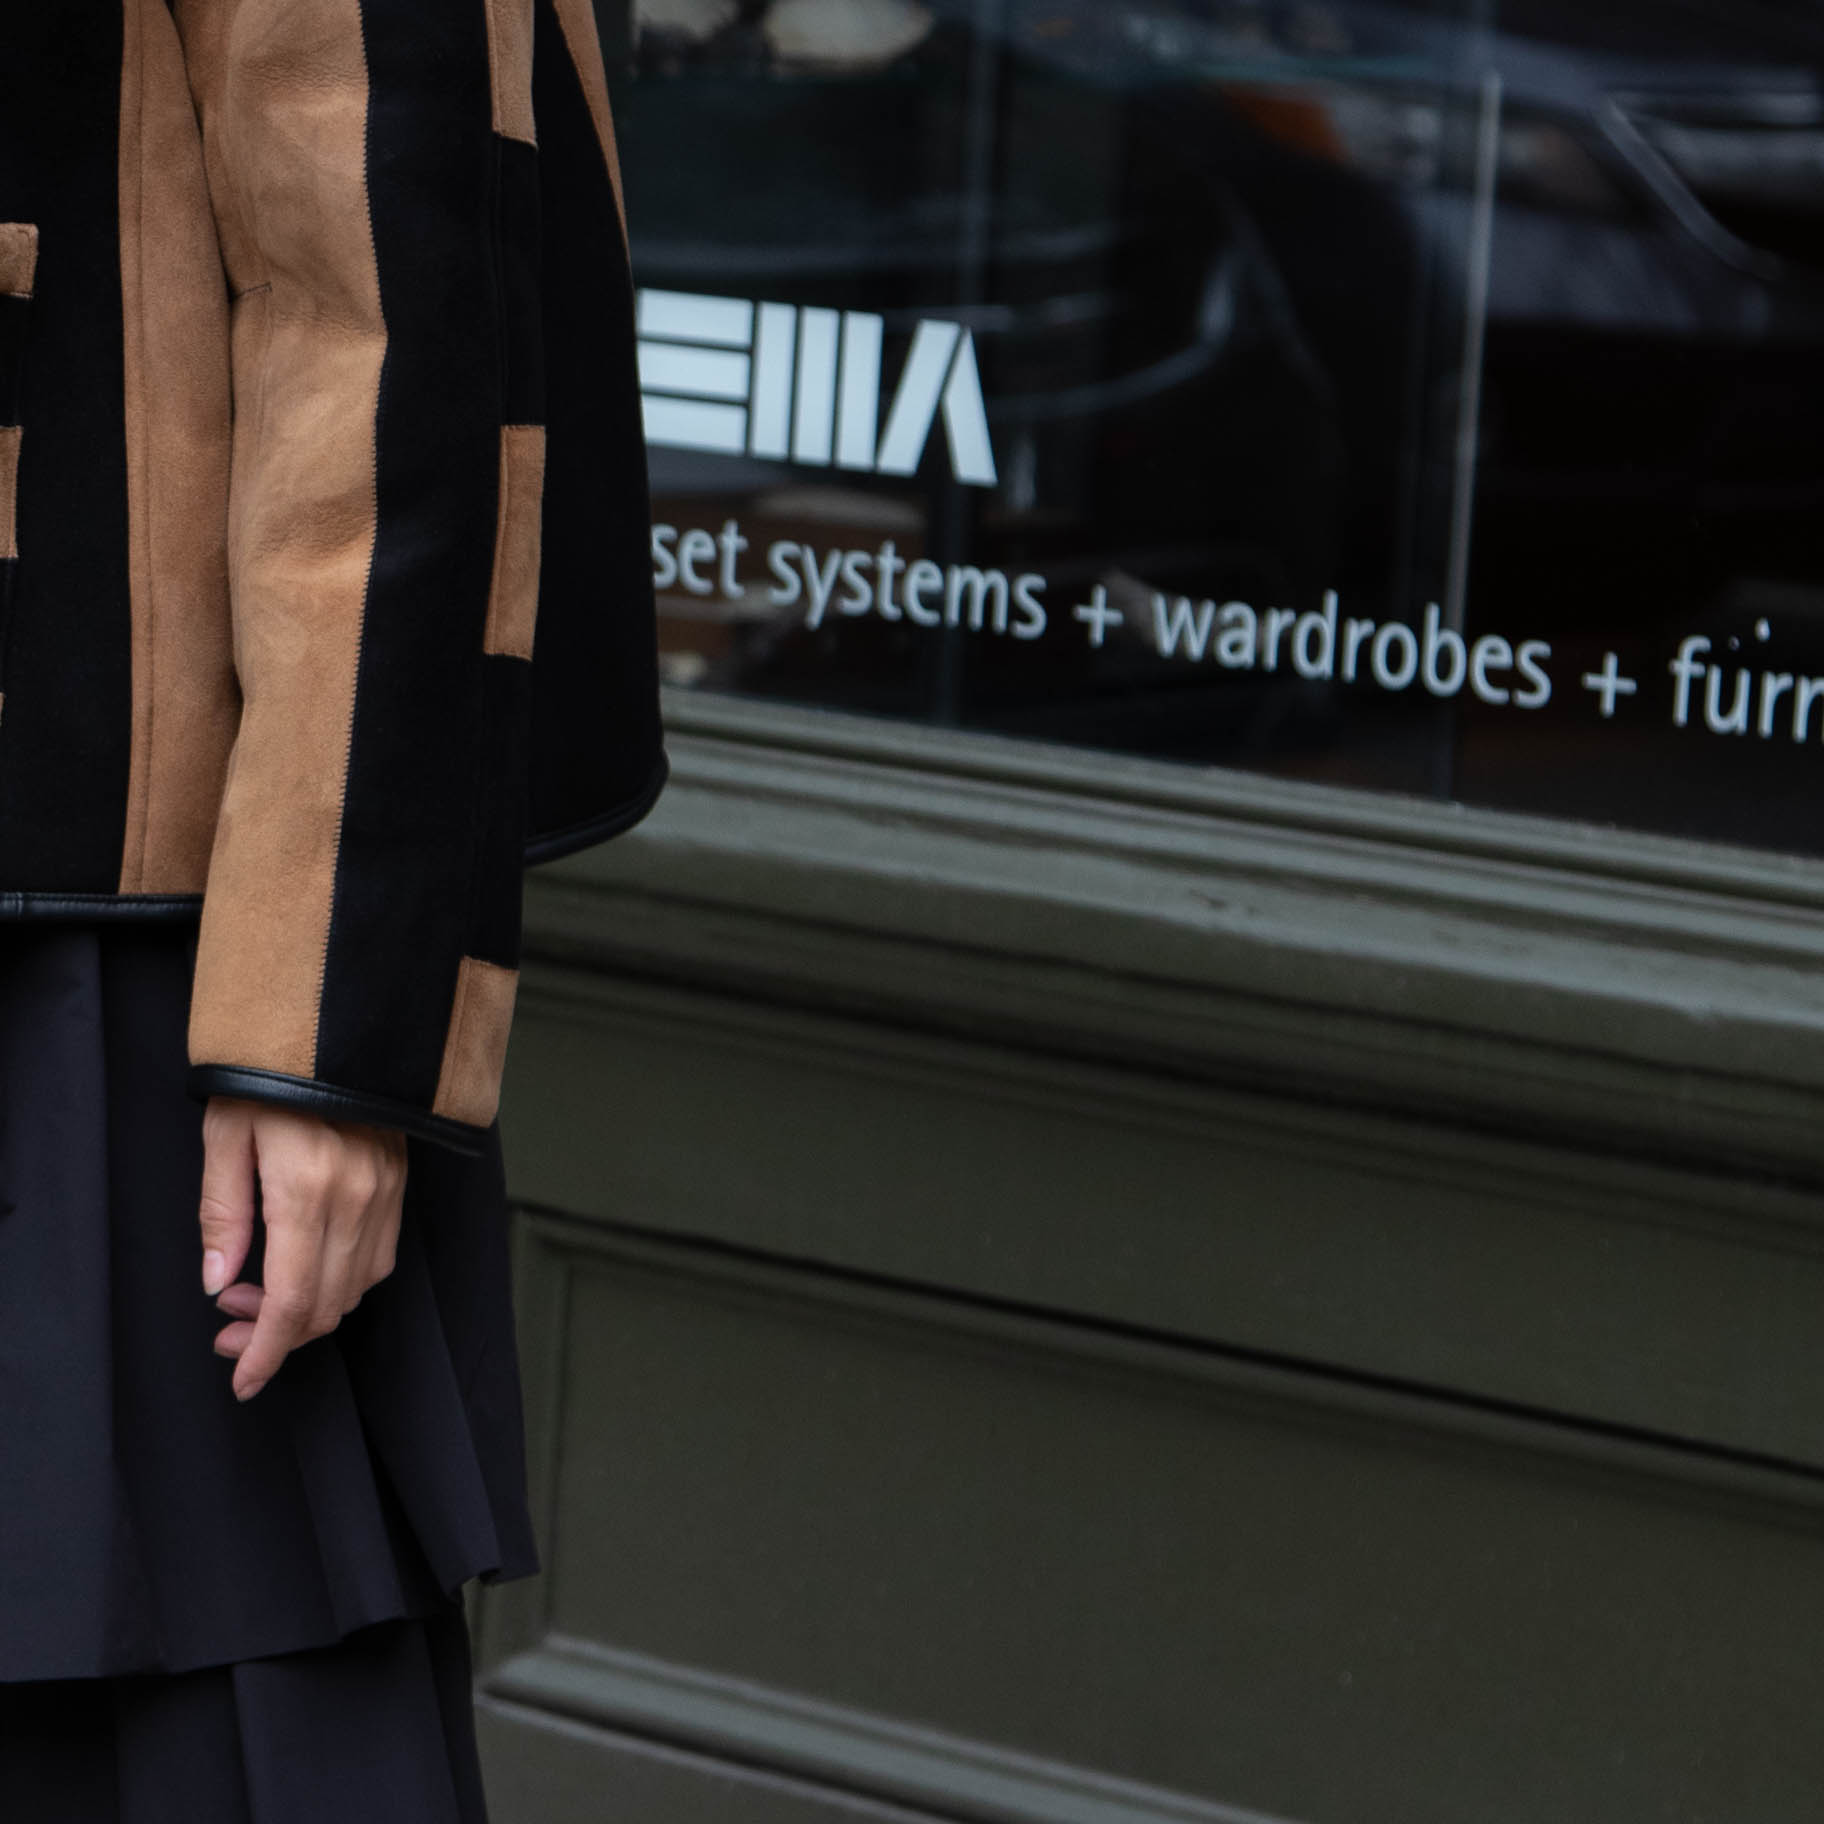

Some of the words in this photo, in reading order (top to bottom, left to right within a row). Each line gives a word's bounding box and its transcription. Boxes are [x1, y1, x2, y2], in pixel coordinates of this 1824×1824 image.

[766, 540, 1048, 641] systems
[1074, 584, 1124, 648] +
[1150, 590, 1553, 709] wardrobes
[1583, 651, 1638, 717] +
